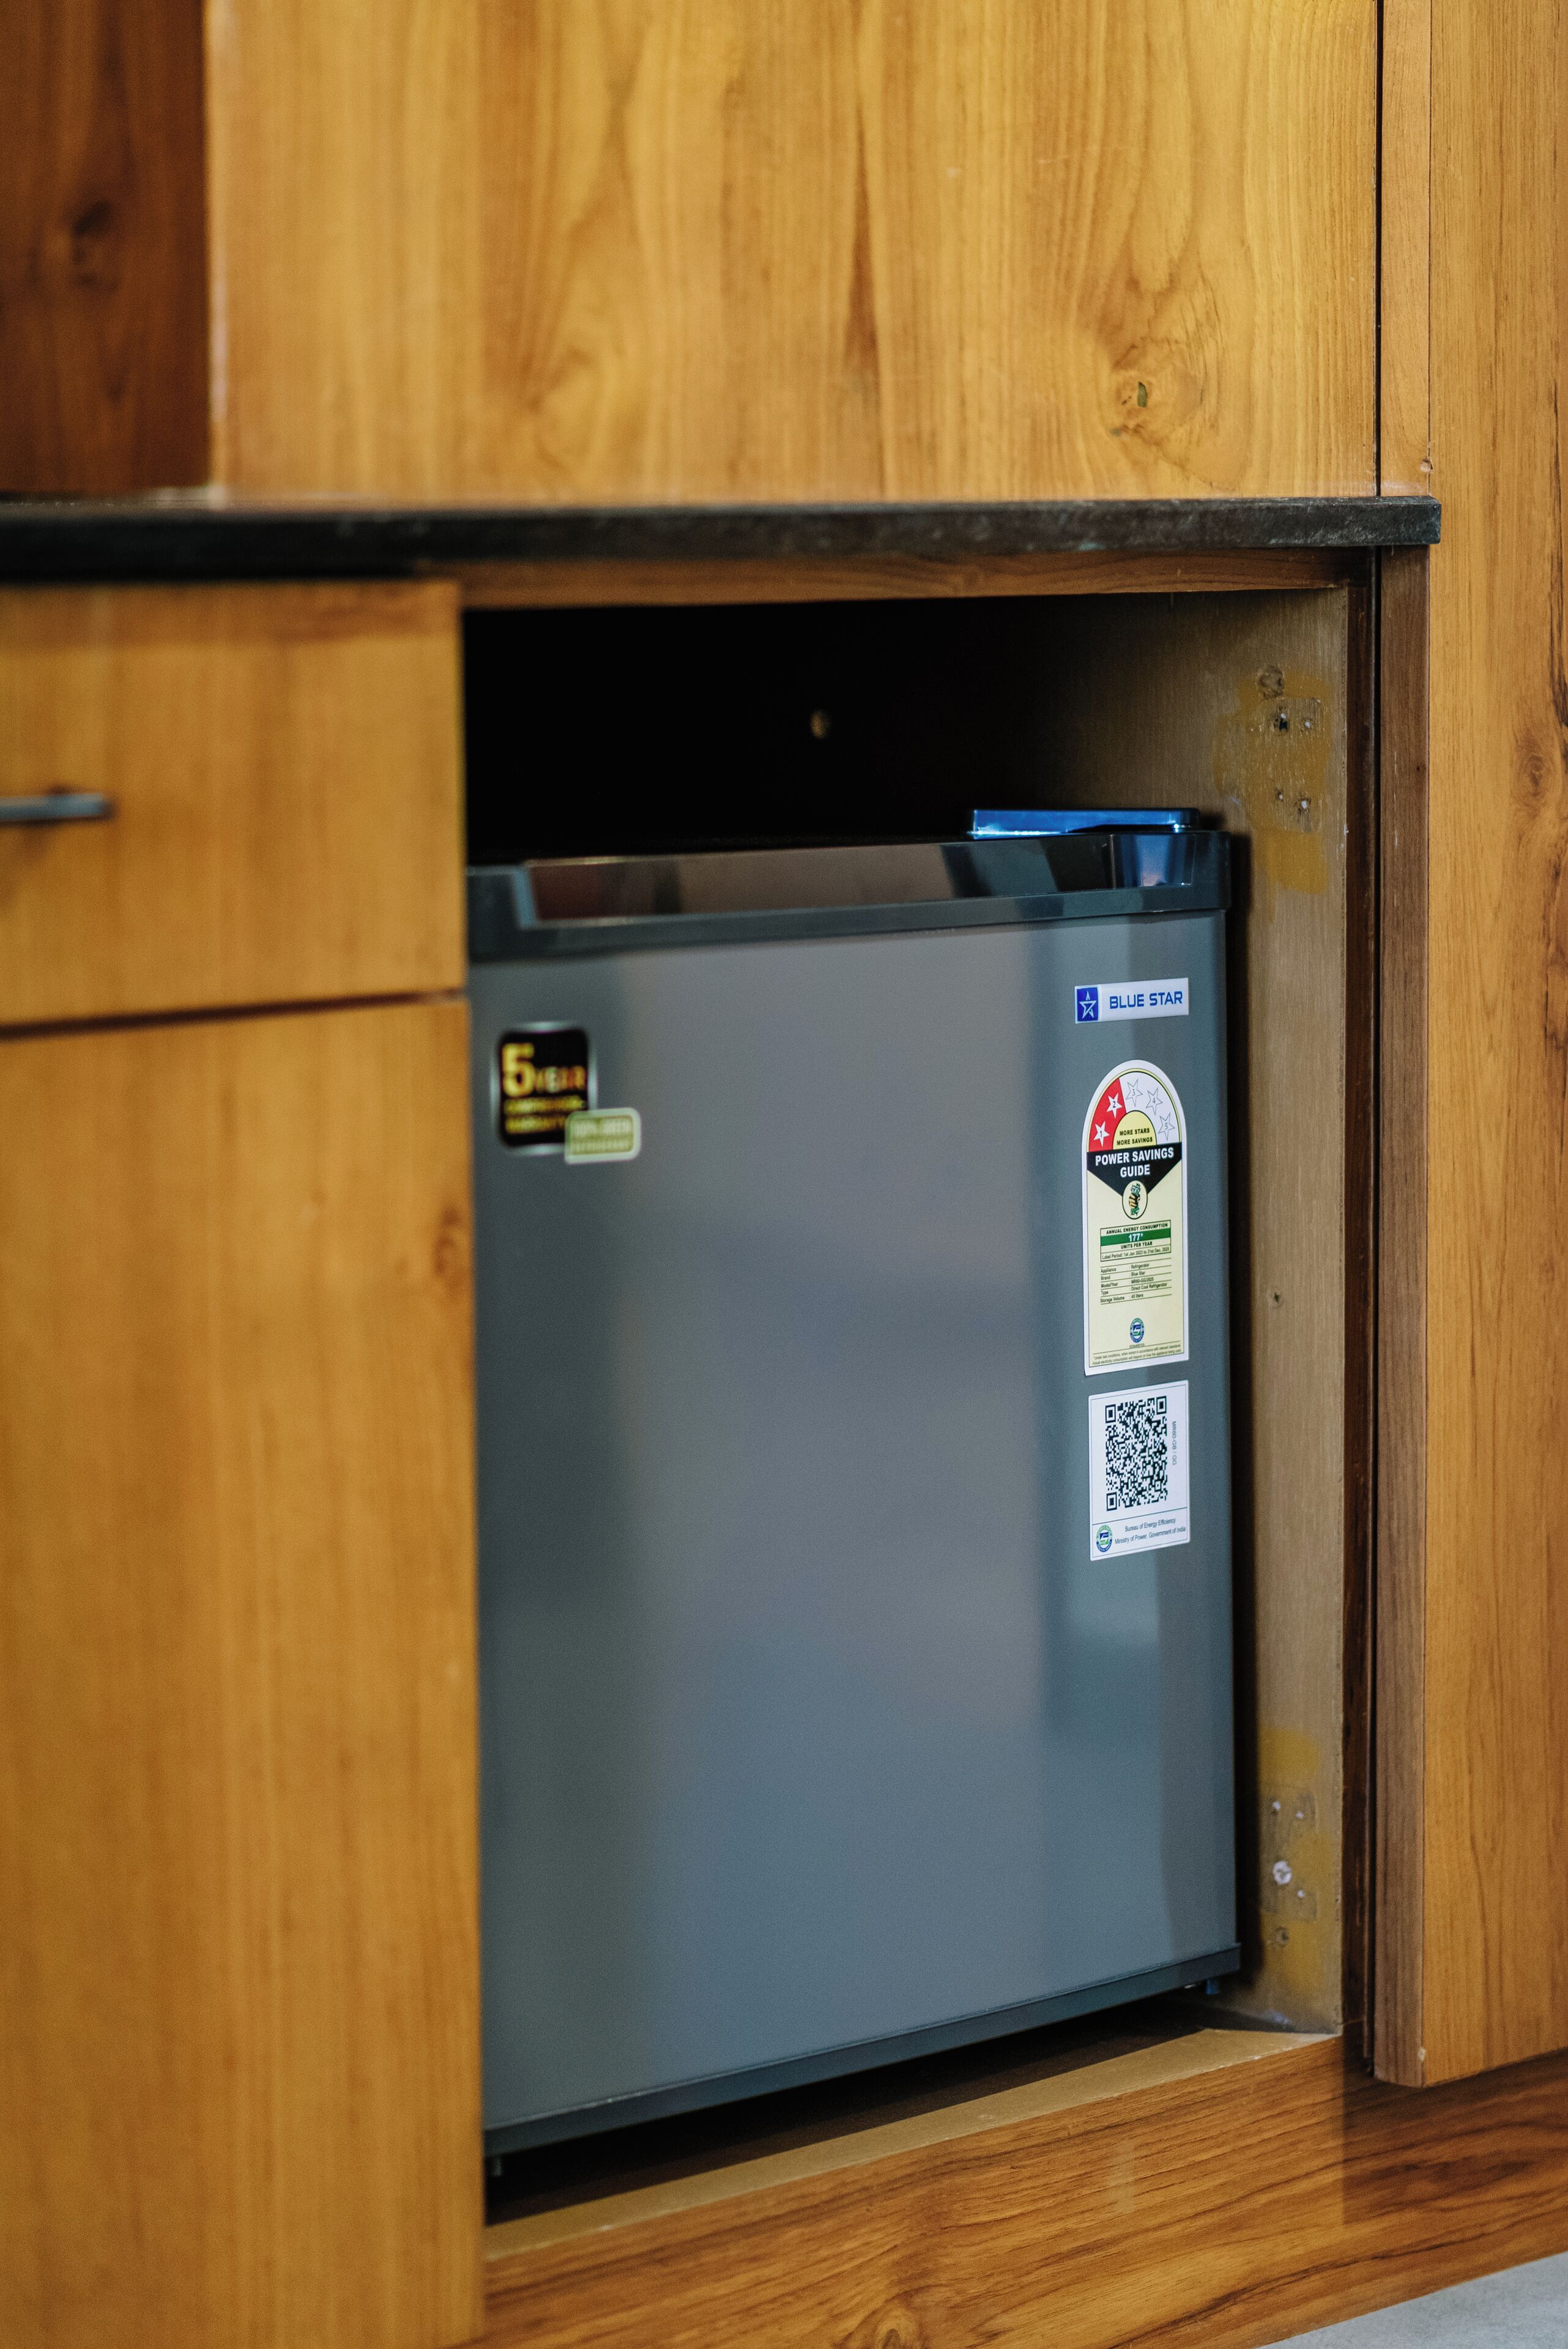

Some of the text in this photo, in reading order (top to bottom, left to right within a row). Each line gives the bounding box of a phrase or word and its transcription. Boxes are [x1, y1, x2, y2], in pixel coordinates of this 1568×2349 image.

[1110, 991, 1183, 1009] BLUE STAR
[502, 1042, 535, 1097] 5
[1095, 1147, 1174, 1166] POWER SAVINGS
[1120, 1164, 1150, 1178] GUIDE
[1149, 1529, 1172, 1538] Government
